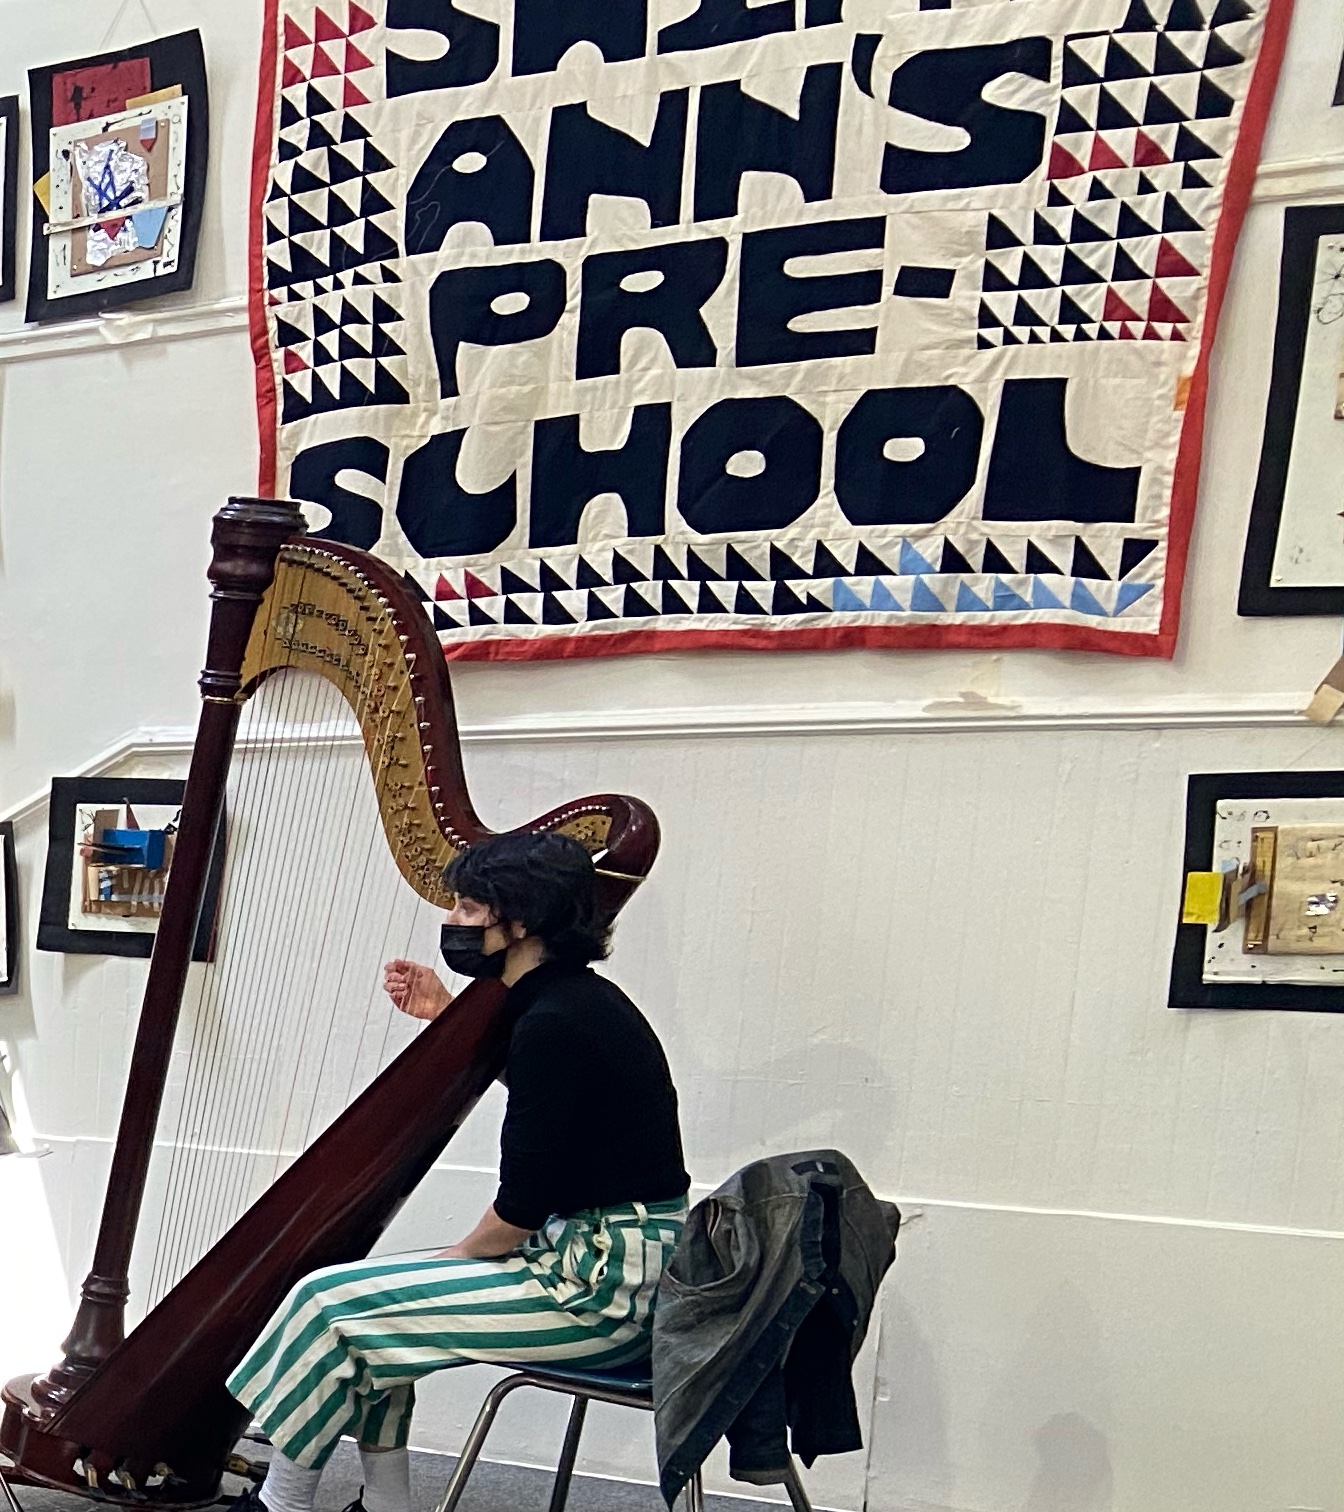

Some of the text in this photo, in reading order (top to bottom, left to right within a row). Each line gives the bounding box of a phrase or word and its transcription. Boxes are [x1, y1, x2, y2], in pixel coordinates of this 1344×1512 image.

[404, 33, 1051, 257] ANN'S
[429, 216, 955, 400] PRE-
[289, 378, 1140, 557] SCHOOL
